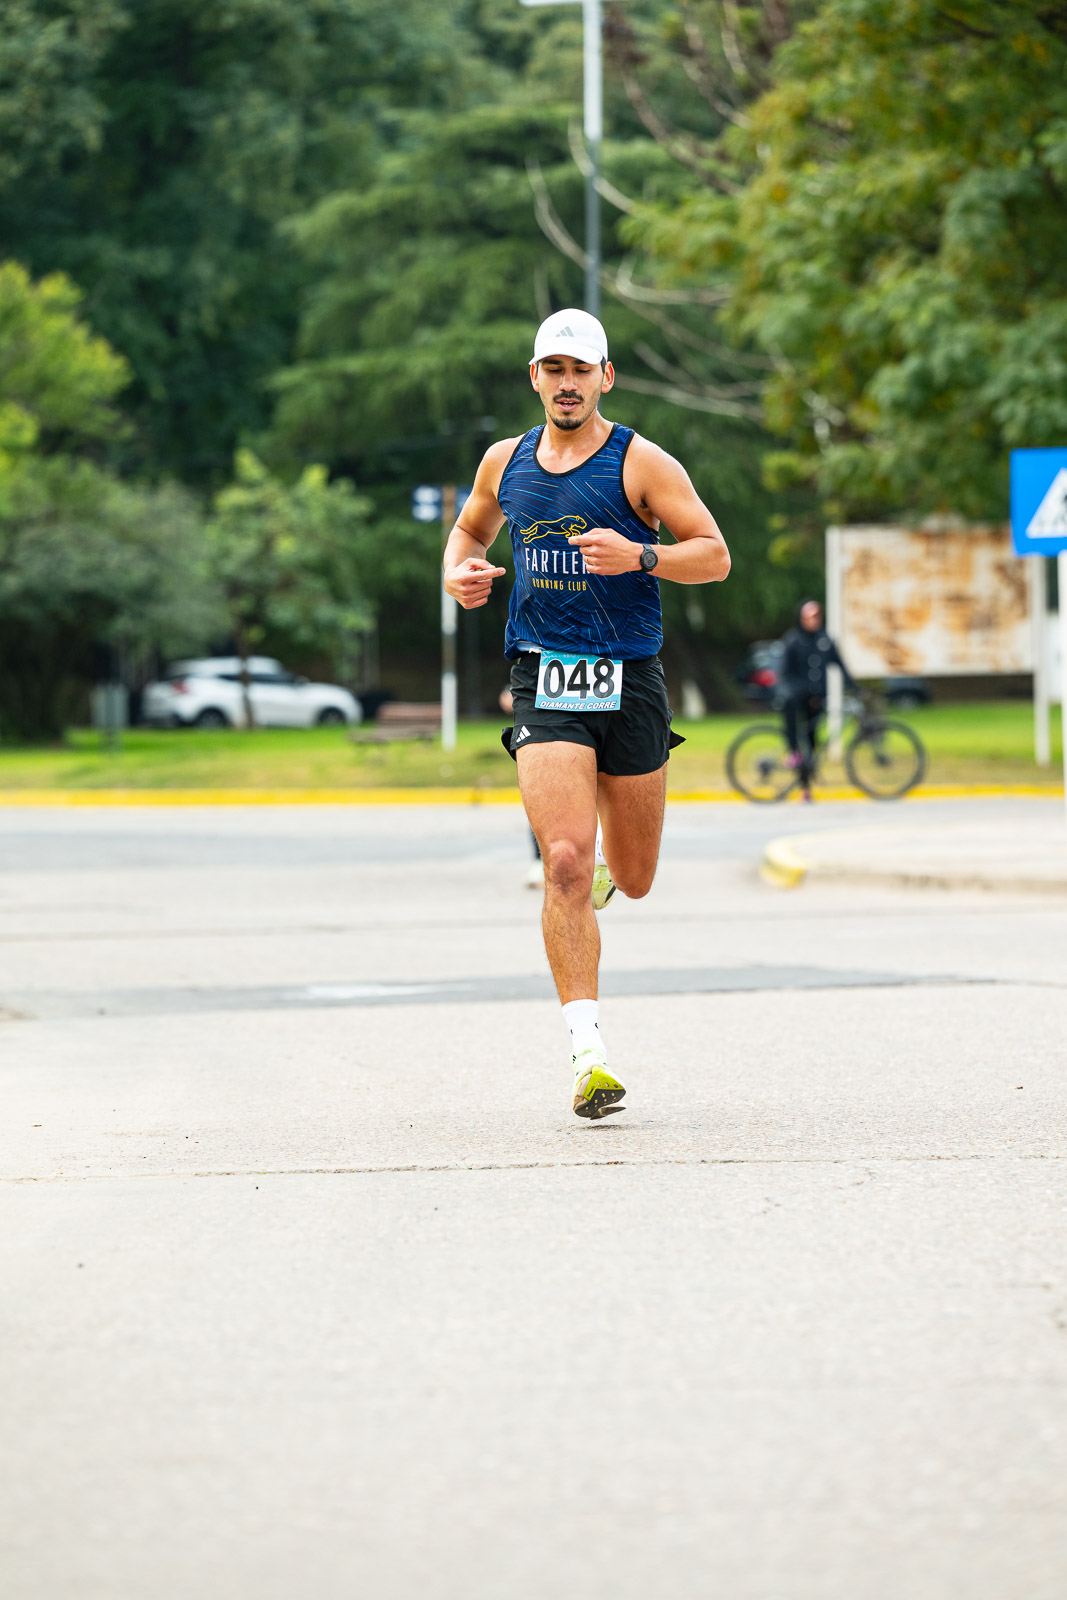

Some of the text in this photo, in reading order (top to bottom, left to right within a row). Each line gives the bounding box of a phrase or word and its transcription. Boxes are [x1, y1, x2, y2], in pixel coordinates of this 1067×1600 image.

[532, 577, 587, 592] RUNNING CLUB
[543, 658, 615, 700] 048
[539, 700, 617, 710] DIAMANTE CORRE
